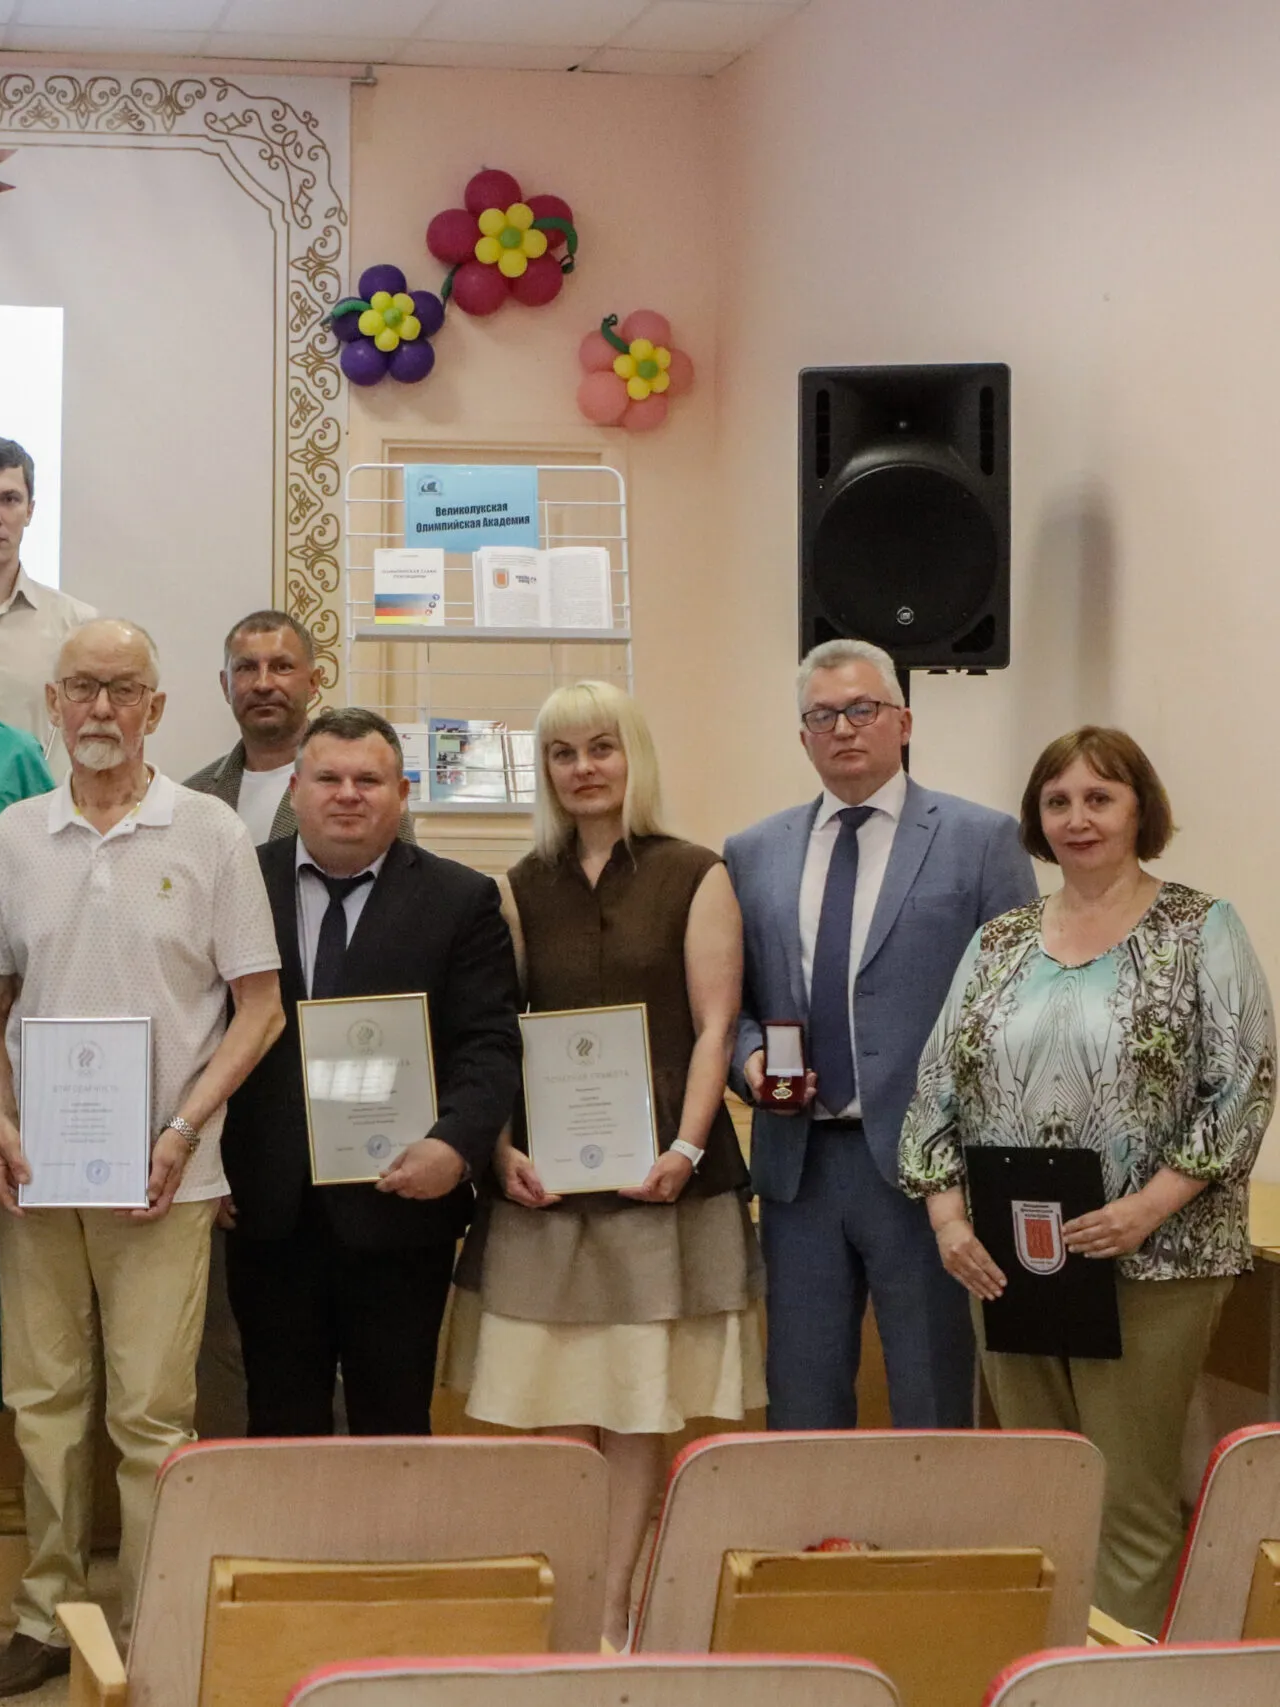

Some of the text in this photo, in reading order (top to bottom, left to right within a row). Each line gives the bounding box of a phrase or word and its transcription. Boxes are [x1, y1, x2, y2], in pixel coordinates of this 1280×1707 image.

[435, 502, 508, 518] Великолукская
[416, 515, 530, 534] Олимпийская Академия
